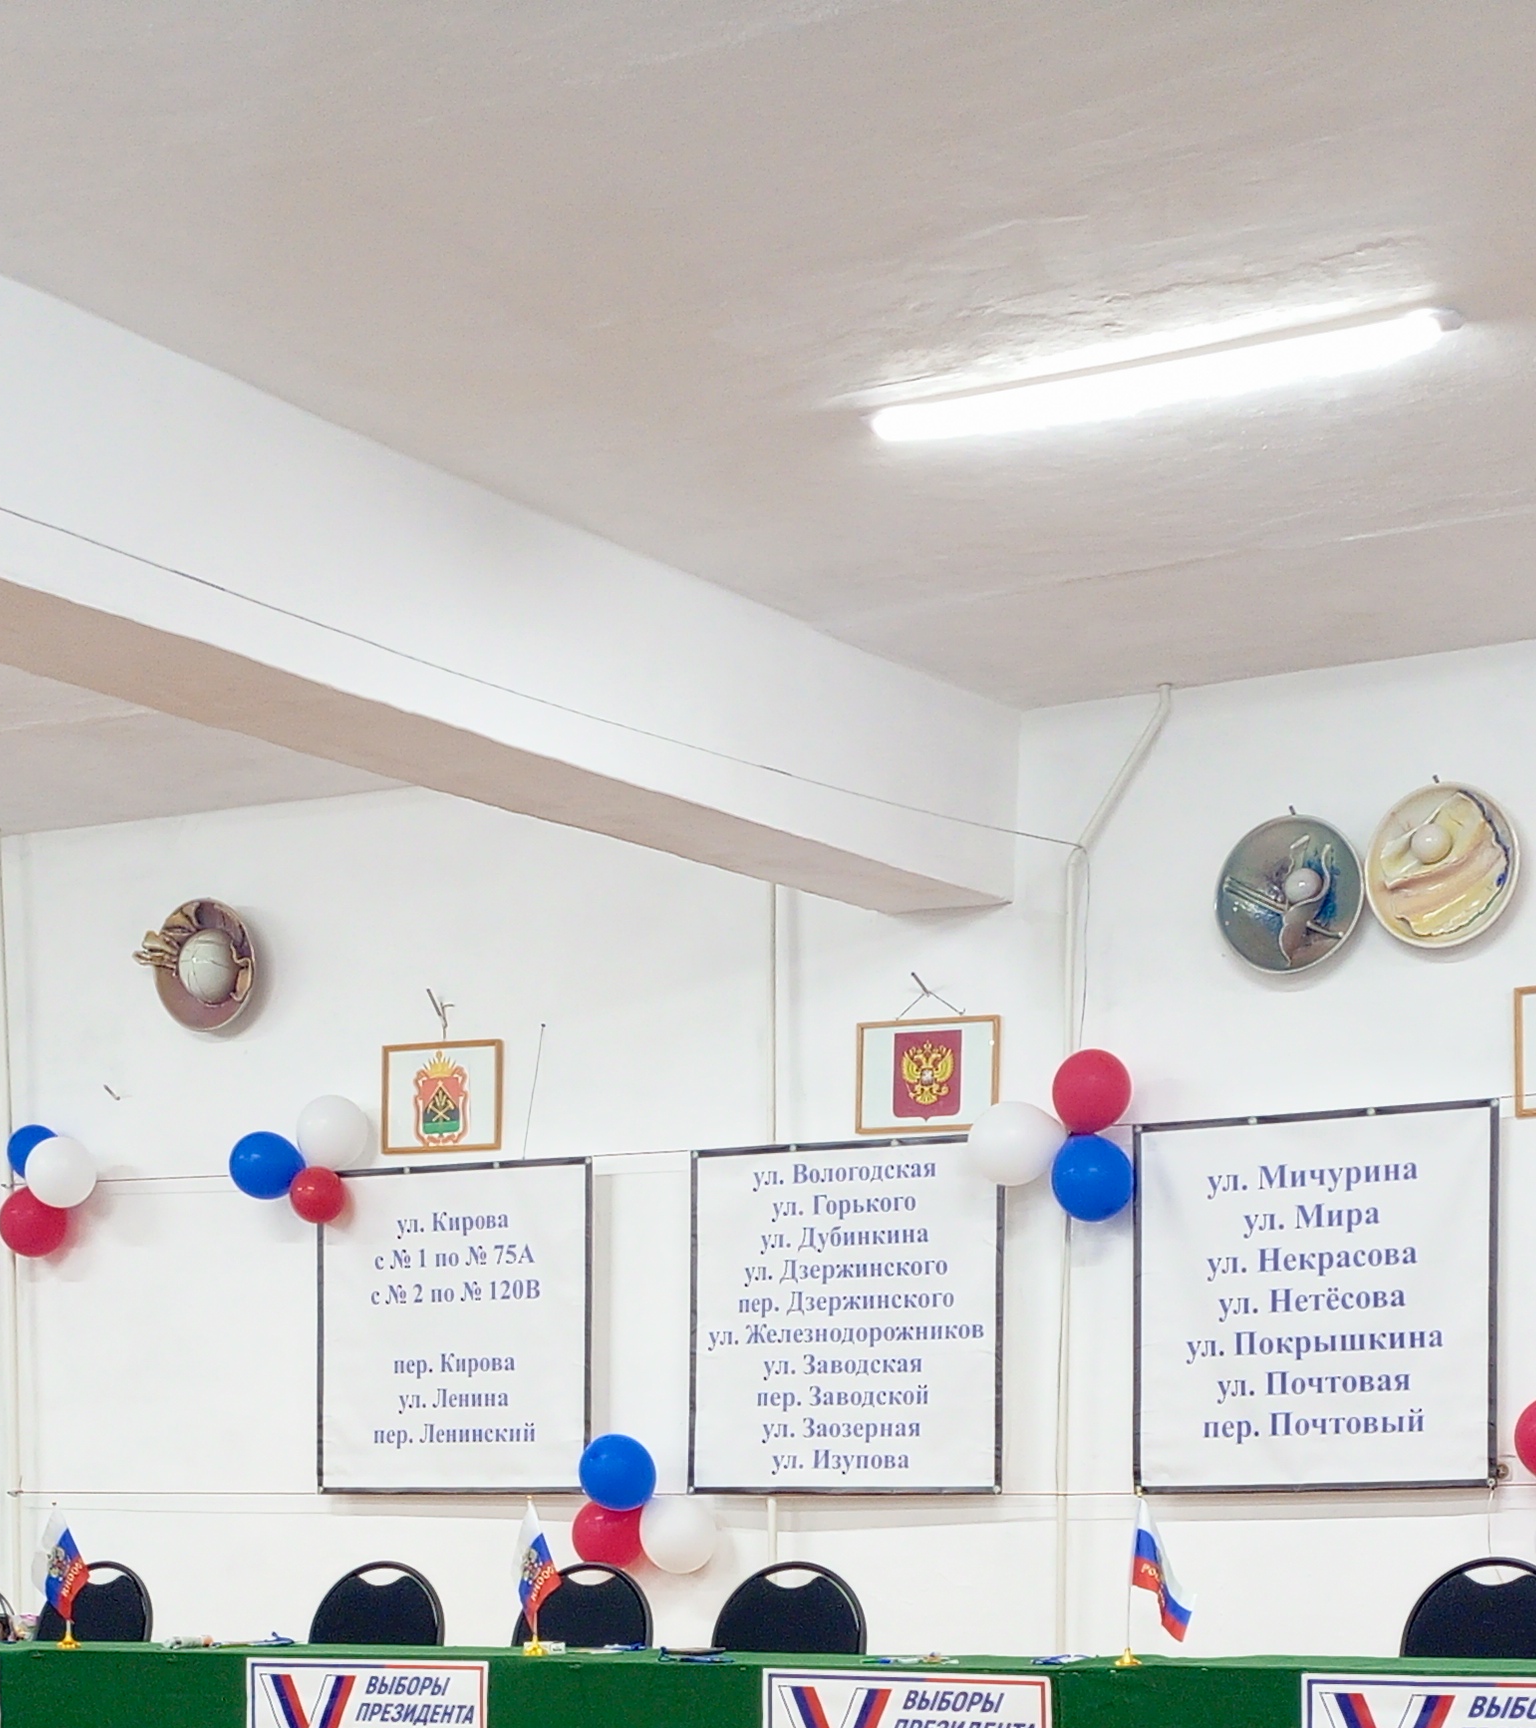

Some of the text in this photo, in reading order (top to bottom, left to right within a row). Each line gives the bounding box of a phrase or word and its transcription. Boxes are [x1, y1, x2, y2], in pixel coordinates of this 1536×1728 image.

[753, 1163, 935, 1192] ул. Вологодская
[1208, 1163, 1417, 1199] ул. Мичурина
[772, 1195, 915, 1222] ул. Горького
[1244, 1204, 1379, 1238] ул. Мира
[397, 1212, 508, 1239] ул. Кирова
[760, 1226, 928, 1255] ул. Дубинкина
[374, 1244, 534, 1270] с № 1 по № 75А
[1207, 1247, 1416, 1281] ул. Некрасова
[744, 1260, 947, 1287] ул. Дзержинского
[371, 1280, 540, 1305] с № 2 по № 120В
[739, 1291, 954, 1318] пер. Дзержинского
[1219, 1288, 1405, 1322] ул. Нетёсова
[708, 1324, 984, 1351] ул. Железнодорожников
[1186, 1330, 1442, 1364] ул. Покрышкина
[394, 1353, 514, 1379] пер. Кирова
[764, 1354, 921, 1381] ул. Заводская
[399, 1388, 508, 1414] ул. Ленина
[758, 1385, 928, 1412] пер. Заводской
[1217, 1372, 1409, 1404] ул. Почтовая
[374, 1423, 534, 1449] пер. Ленинский
[762, 1418, 919, 1444] ул. Заозерная
[1204, 1408, 1423, 1444] пер. Почтовый
[772, 1450, 908, 1475] ул. Изупова
[366, 1676, 450, 1696] ВЫБОРЫ
[356, 1703, 475, 1726] ПРЕЗИДЕНТА
[902, 1690, 1004, 1713] ВЫБОРЫ
